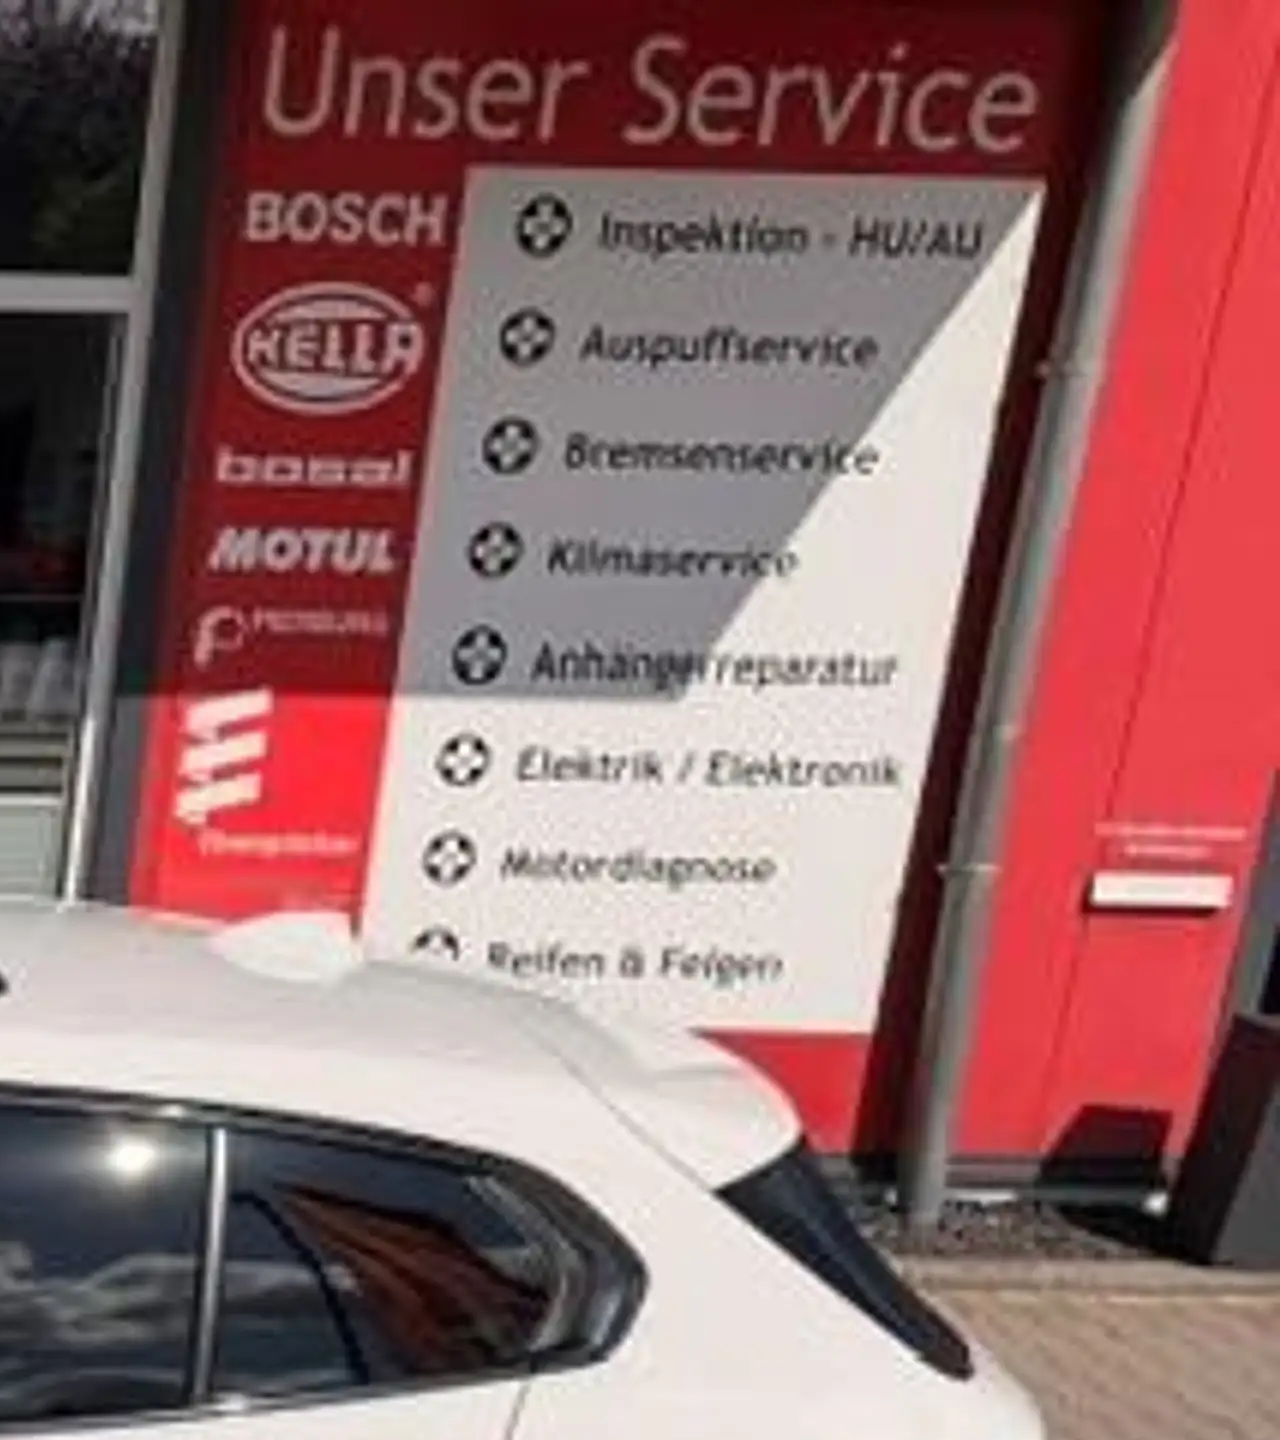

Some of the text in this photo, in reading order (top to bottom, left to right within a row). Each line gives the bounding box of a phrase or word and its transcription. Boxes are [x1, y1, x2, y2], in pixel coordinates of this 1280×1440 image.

[262, 25, 1040, 153] Unser Service
[244, 190, 448, 246] BOSCH
[598, 210, 809, 262] Inspektion
[848, 212, 983, 260] HU/AU
[245, 320, 421, 374] HELLA
[580, 322, 879, 371] Auspuffservice
[563, 432, 880, 478] Bremsenservice
[208, 526, 394, 573] MOTUL
[547, 536, 798, 578] Klimaservice
[516, 745, 663, 784] Elektrik
[704, 748, 900, 788] Elektronik
[500, 846, 777, 892] Motordiagnose
[488, 941, 606, 980] Reifen
[660, 948, 783, 988] Felgen
